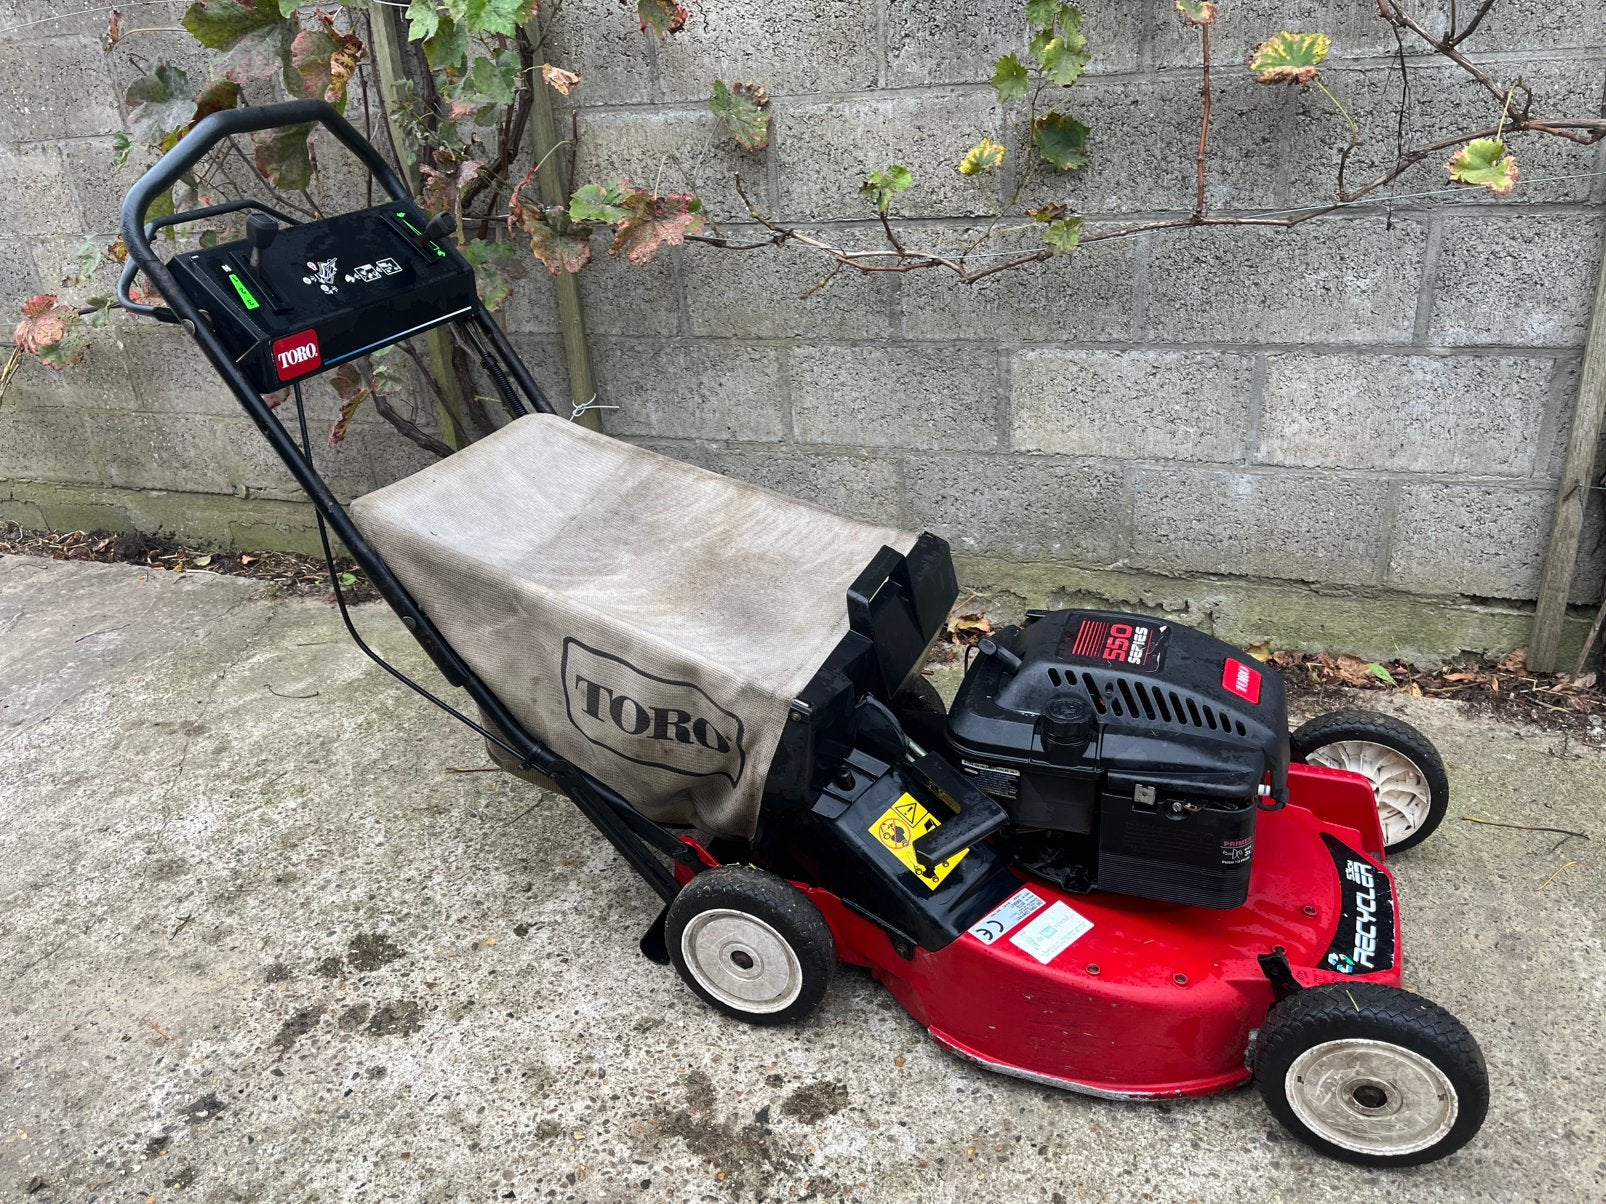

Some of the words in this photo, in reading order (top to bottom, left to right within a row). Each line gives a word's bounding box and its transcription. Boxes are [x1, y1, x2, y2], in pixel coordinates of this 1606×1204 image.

[277, 342, 318, 369] TORO
[1103, 623, 1133, 662] 550
[1127, 626, 1148, 665] SERIES
[575, 674, 731, 754] TORO
[1353, 861, 1377, 968] RECYCLER
